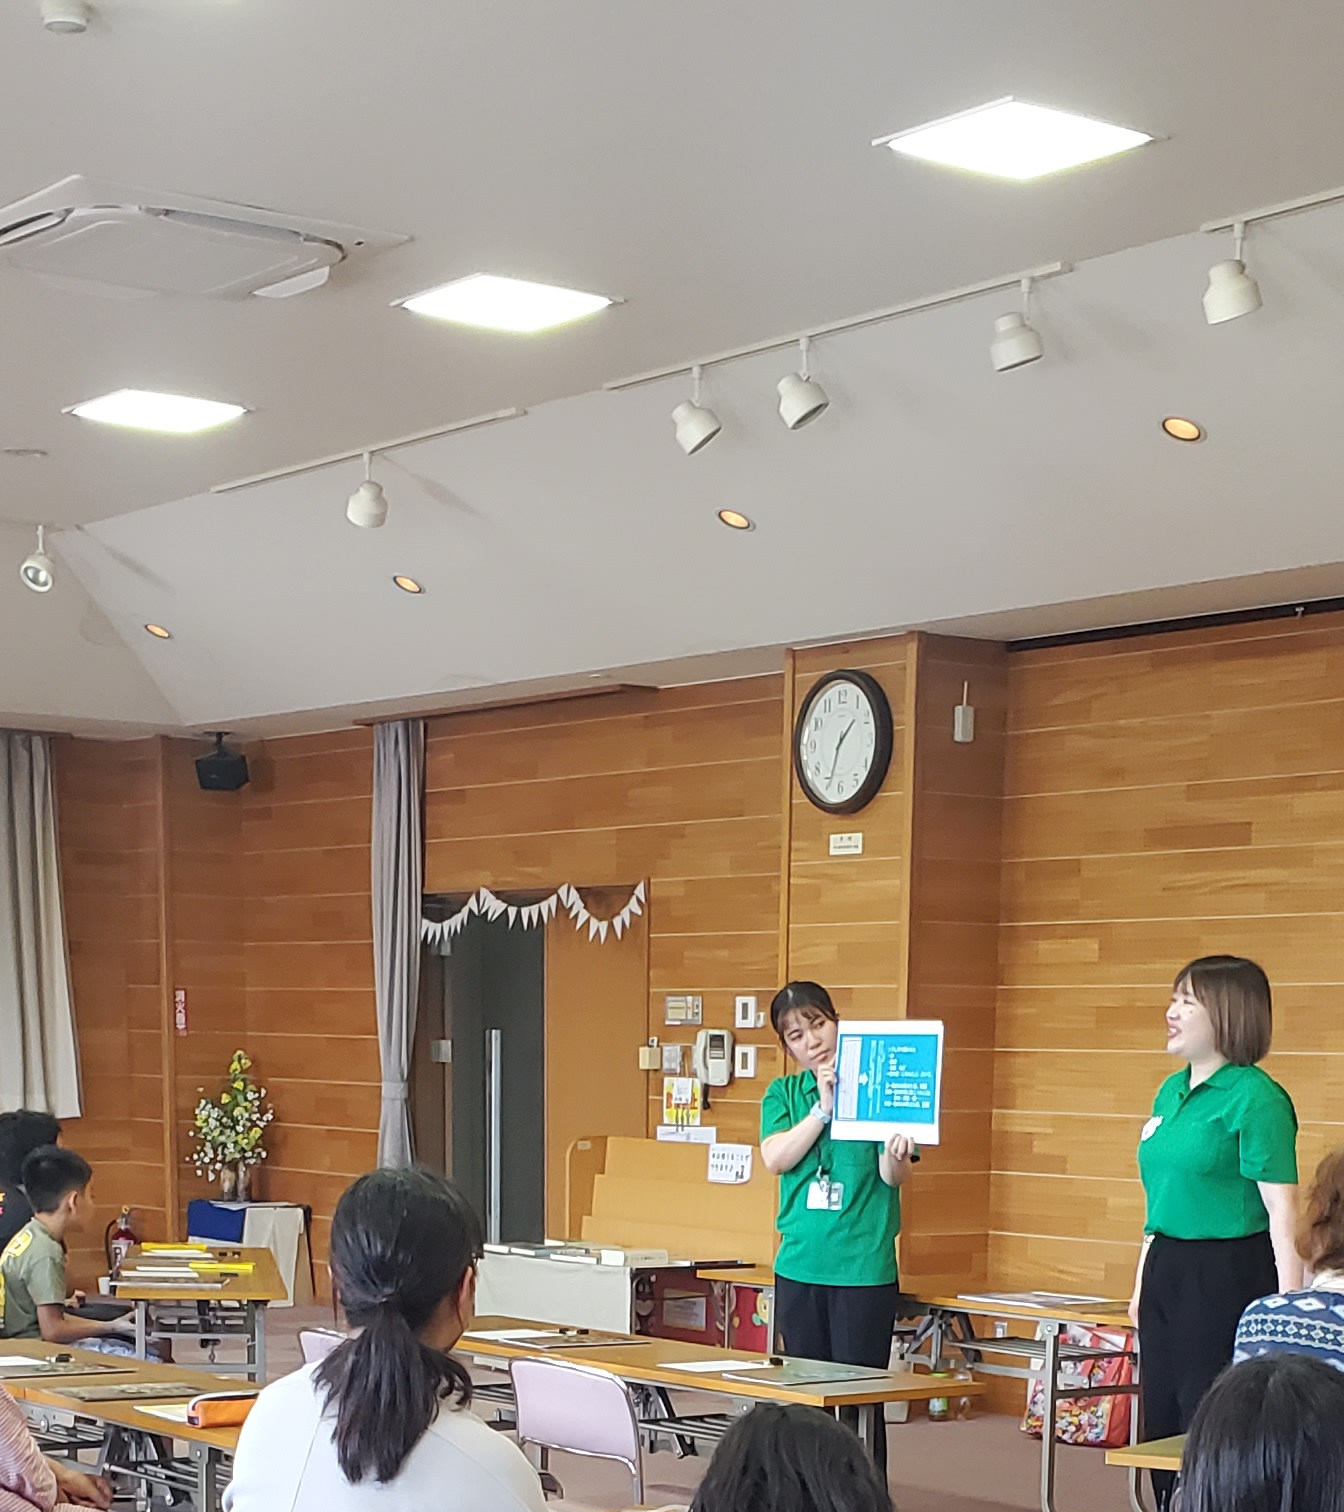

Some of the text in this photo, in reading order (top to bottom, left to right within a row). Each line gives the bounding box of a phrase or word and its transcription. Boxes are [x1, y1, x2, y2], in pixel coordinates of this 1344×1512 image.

[838, 689, 847, 705] 12
[824, 698, 831, 713] 11
[814, 717, 823, 732] 10
[810, 740, 816, 753] 9
[815, 761, 821, 777] 8
[837, 780, 844, 795] 6
